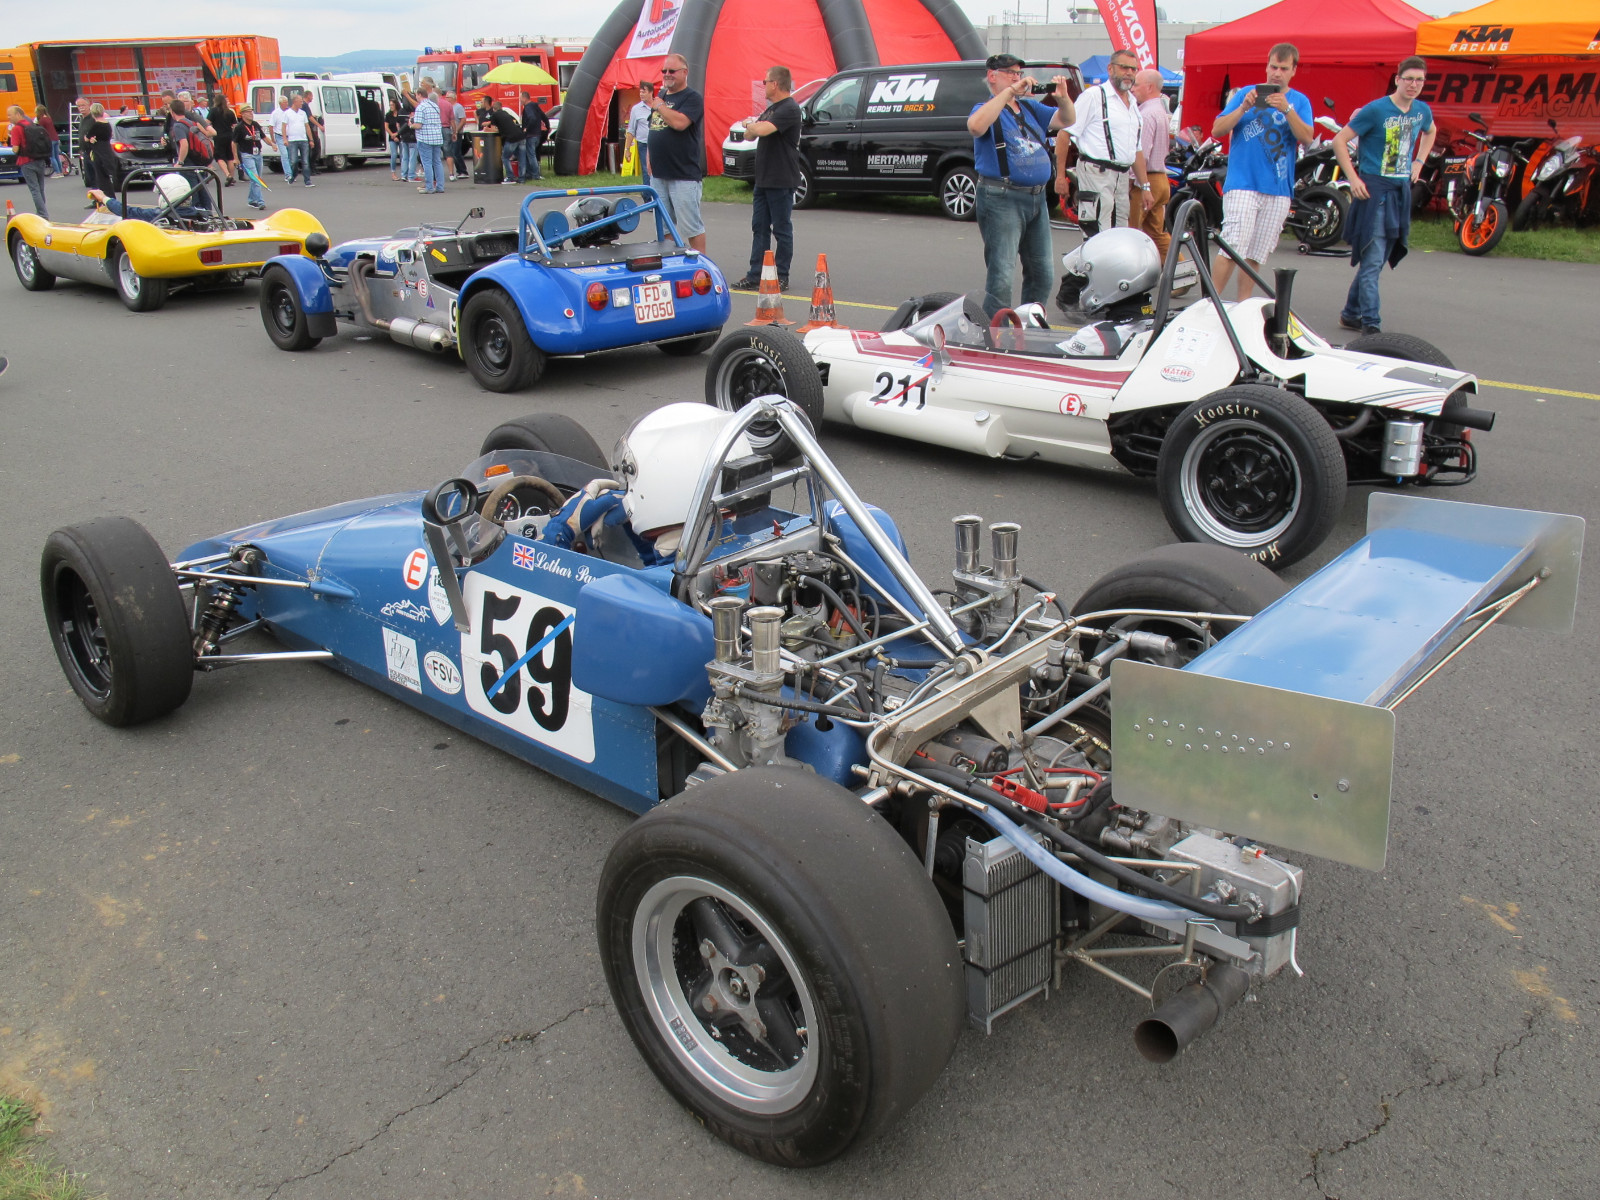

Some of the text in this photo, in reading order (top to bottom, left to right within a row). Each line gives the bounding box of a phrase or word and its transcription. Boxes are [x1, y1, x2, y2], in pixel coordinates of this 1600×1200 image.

[1454, 24, 1514, 43] KTM
[1449, 42, 1509, 52] RACING
[869, 73, 939, 103] KTM
[1386, 72, 1600, 103] ERTRAM
[867, 105, 892, 113] READY
[903, 104, 925, 112] RACE
[867, 155, 928, 165] HERTRAMPF
[644, 286, 660, 302] FD
[637, 301, 673, 320] 07050
[750, 336, 787, 372] Hoosier
[1071, 341, 1086, 352] OMP
[869, 371, 929, 410] 211
[1066, 397, 1076, 412] E
[1193, 399, 1260, 429] Hoosier
[1243, 540, 1281, 562] Hoo
[406, 551, 426, 587] E
[534, 551, 572, 579] Lothar
[432, 659, 452, 684] FSV
[480, 590, 572, 732] 59
